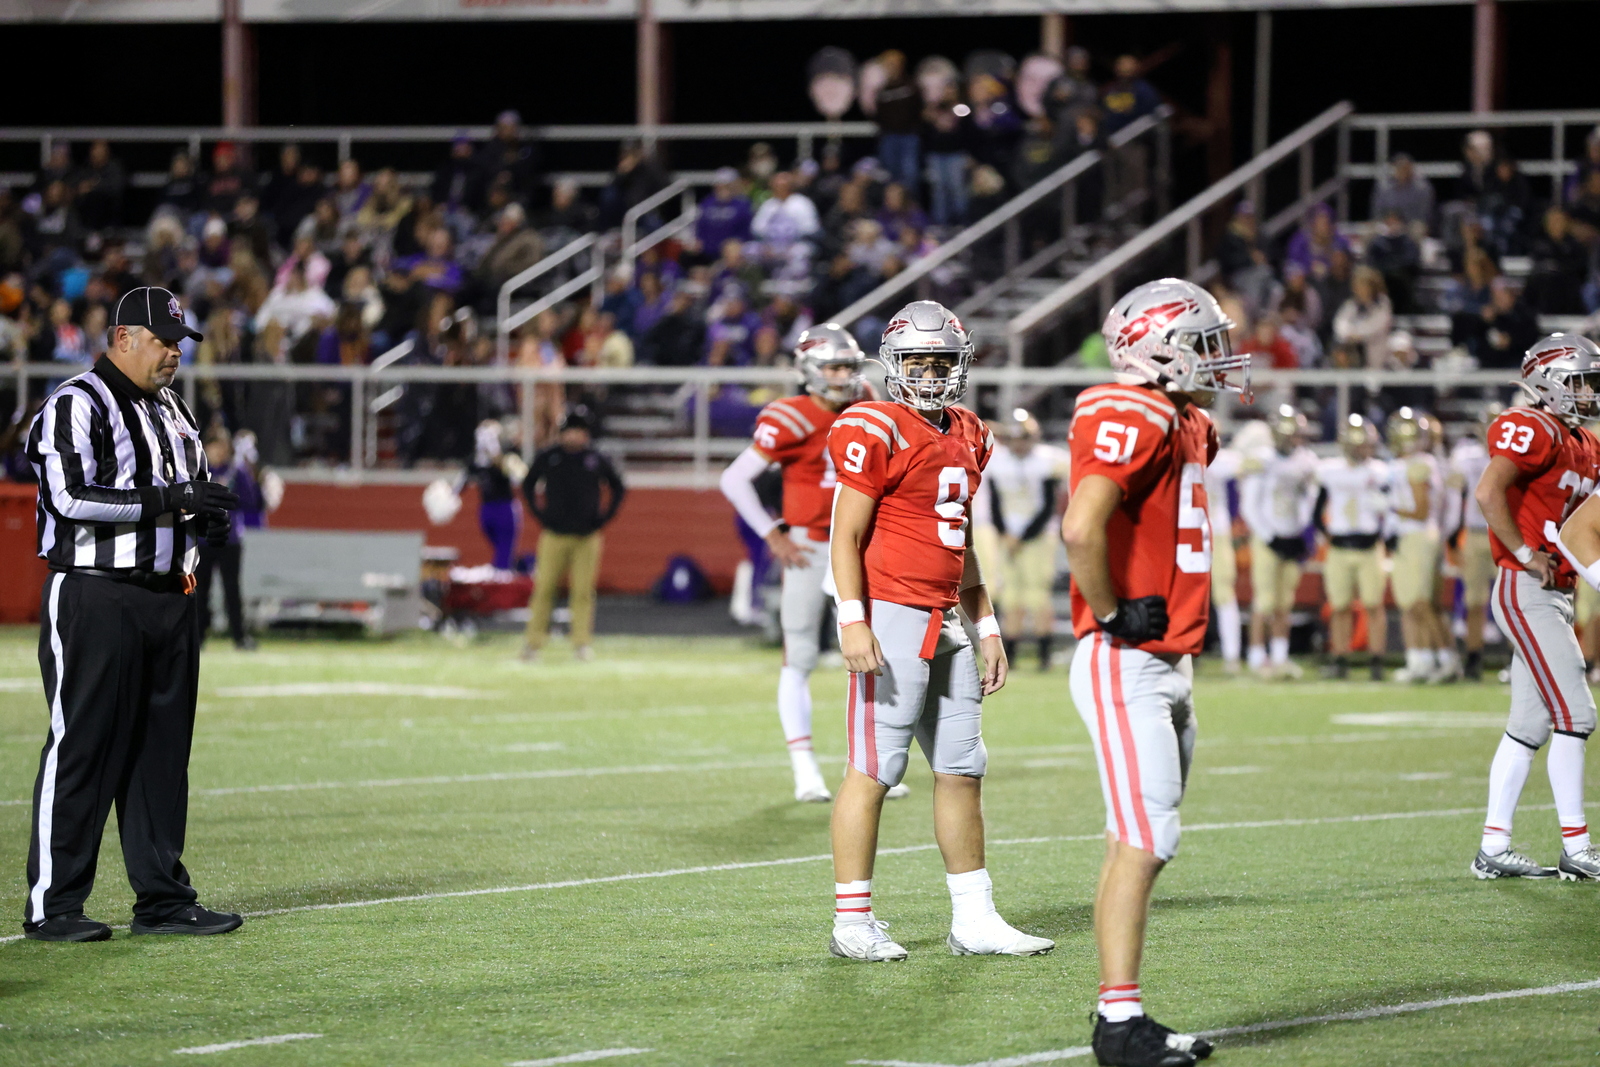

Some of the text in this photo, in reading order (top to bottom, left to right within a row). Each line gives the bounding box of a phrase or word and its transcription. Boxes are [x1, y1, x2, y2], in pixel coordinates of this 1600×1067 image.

[1093, 420, 1140, 465] 51
[1496, 421, 1535, 454] 33
[843, 441, 867, 474] 9
[934, 466, 969, 548] 9
